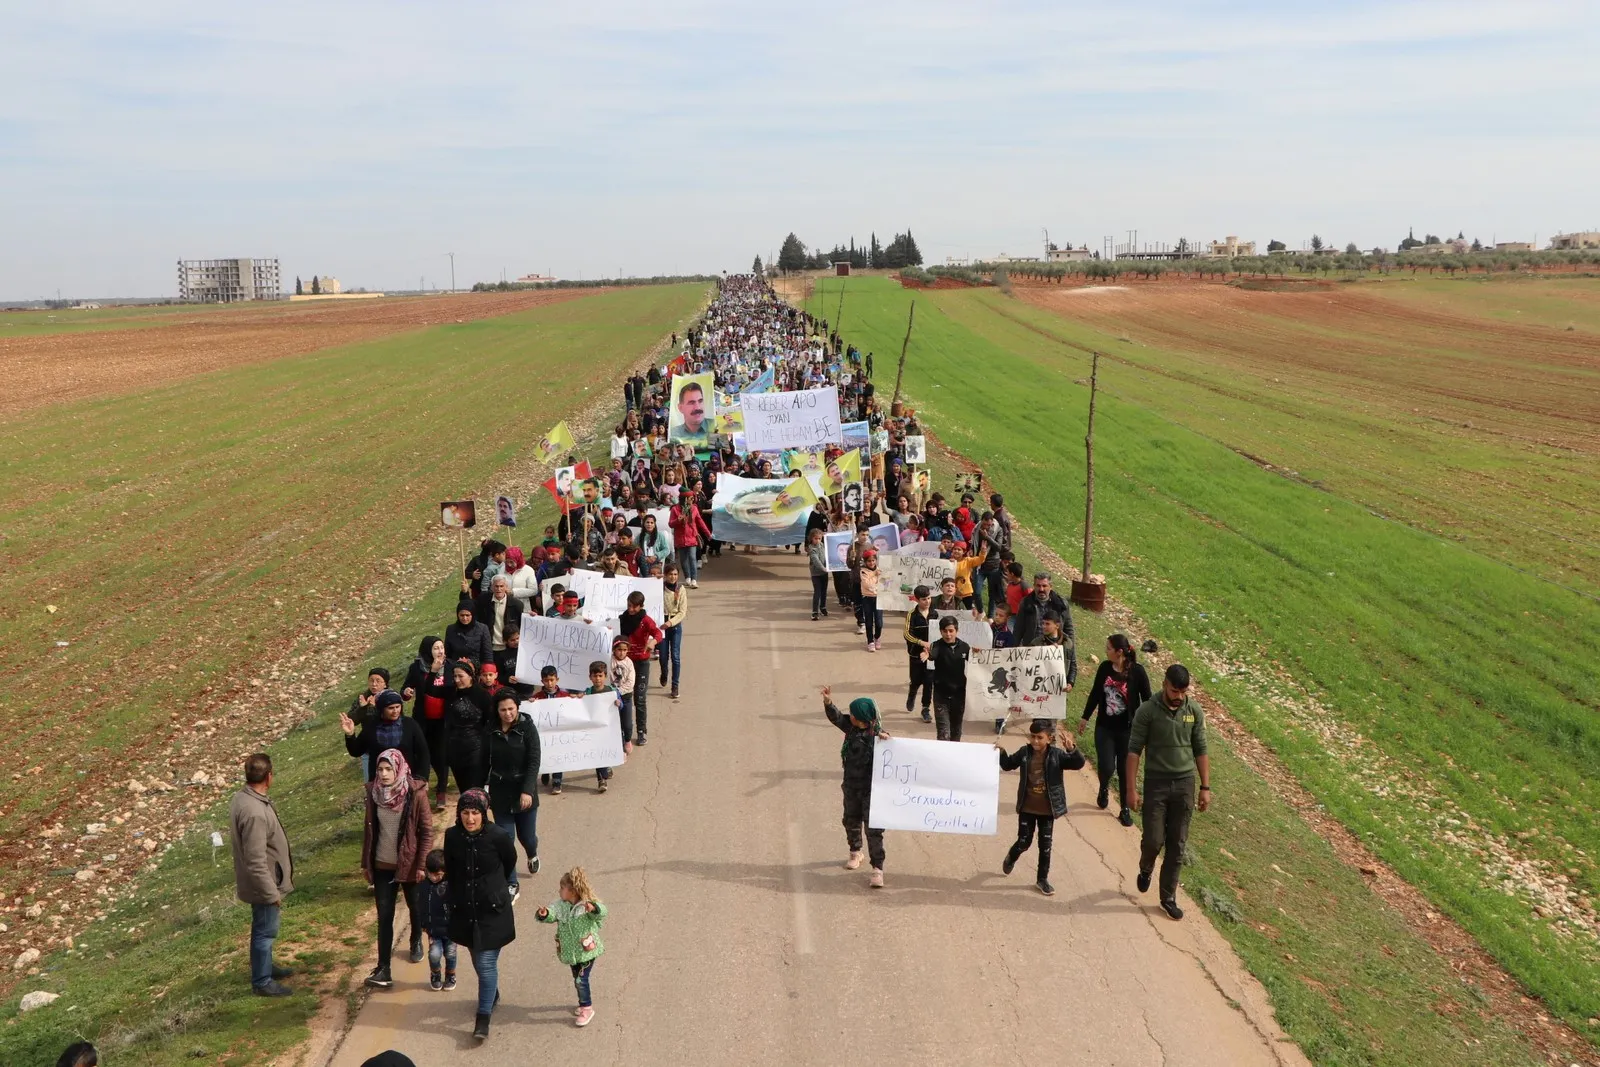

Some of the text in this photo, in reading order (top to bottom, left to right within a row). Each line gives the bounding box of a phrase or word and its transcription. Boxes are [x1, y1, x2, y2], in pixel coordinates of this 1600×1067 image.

[791, 392, 816, 409] APO
[1006, 648, 1031, 662] XWE
[1025, 665, 1040, 676] ME
